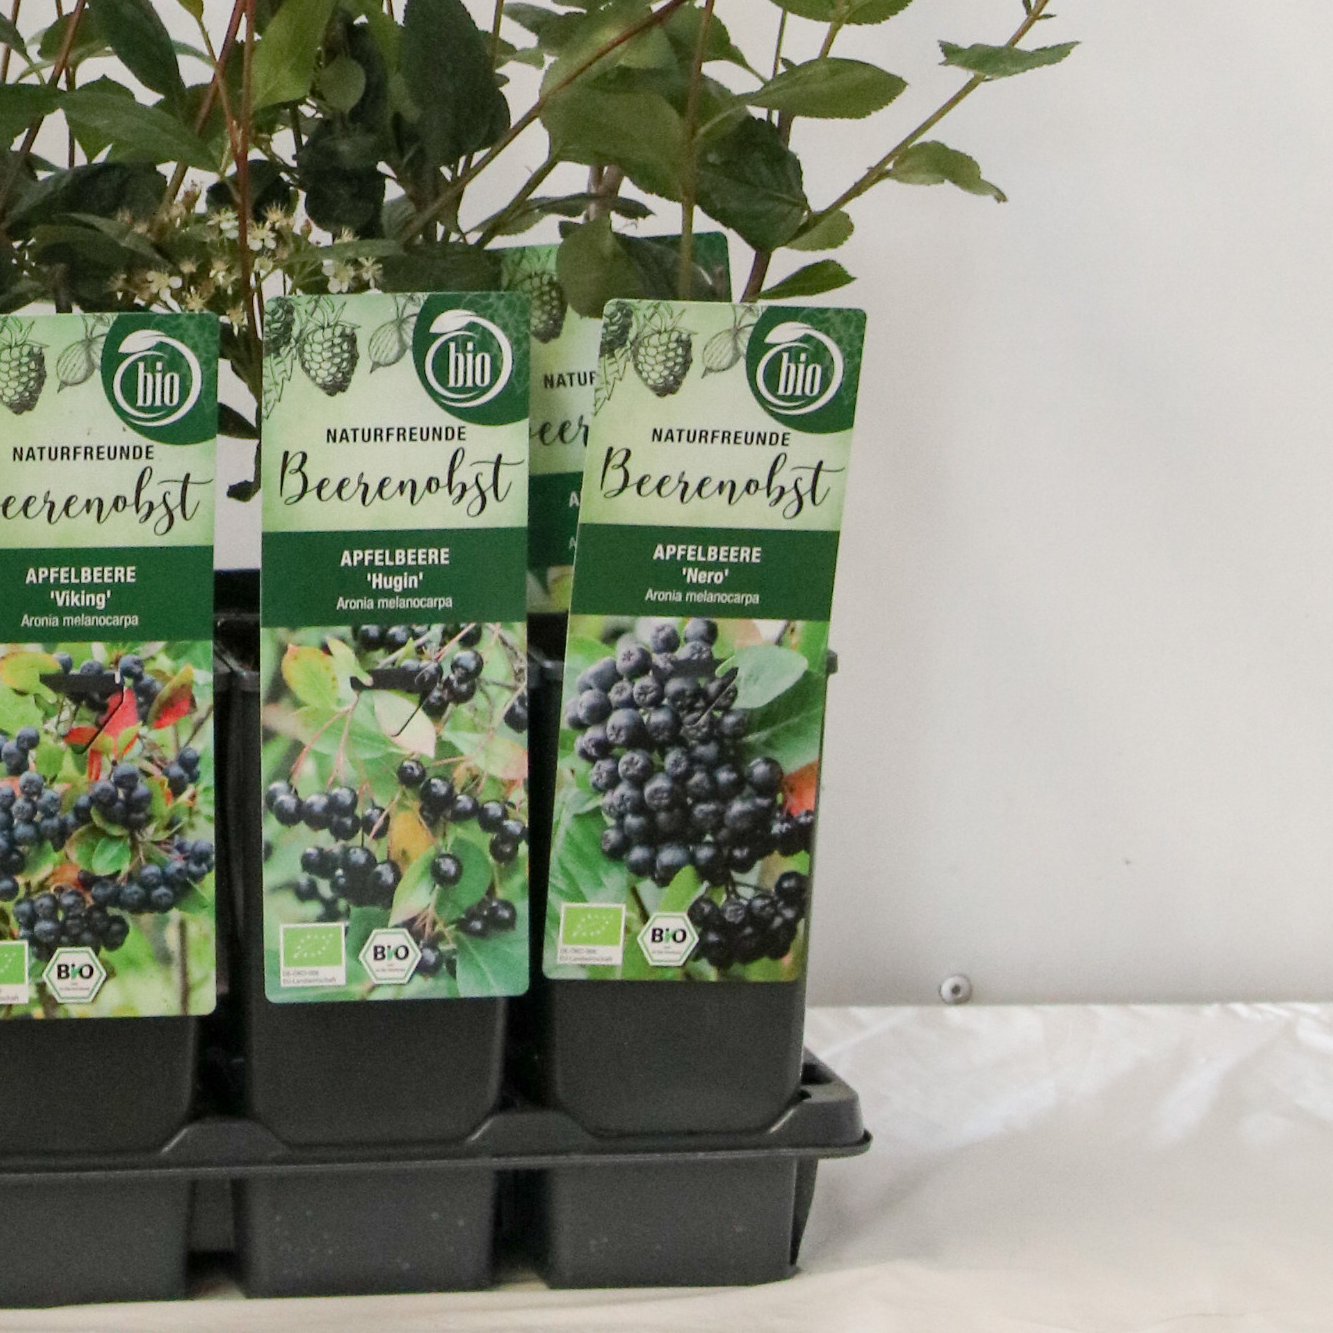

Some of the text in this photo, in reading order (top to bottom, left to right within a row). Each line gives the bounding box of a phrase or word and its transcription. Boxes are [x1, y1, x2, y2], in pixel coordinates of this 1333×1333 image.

[448, 342, 490, 387] bio
[777, 352, 822, 397] bio
[136, 362, 179, 406] bio
[327, 426, 465, 443] NATURFREUNDE
[652, 428, 791, 446] NATURFREUNDE
[13, 445, 153, 461] NATURFREUNDE
[280, 448, 525, 517] Beerenobst
[601, 446, 845, 519] Beerenobst
[341, 548, 449, 566] APFELBEERE
[653, 544, 761, 562] APFELBEERE
[26, 566, 136, 583] APFELBEERE
[368, 572, 423, 592] 'Hugin'
[683, 568, 728, 584] 'Nero'
[51, 590, 110, 609] 'Viking'
[337, 596, 452, 610] Aronia melanocarpa
[645, 589, 759, 605] Aronia melanocarpa
[21, 614, 138, 628] Aronia melanocarpa
